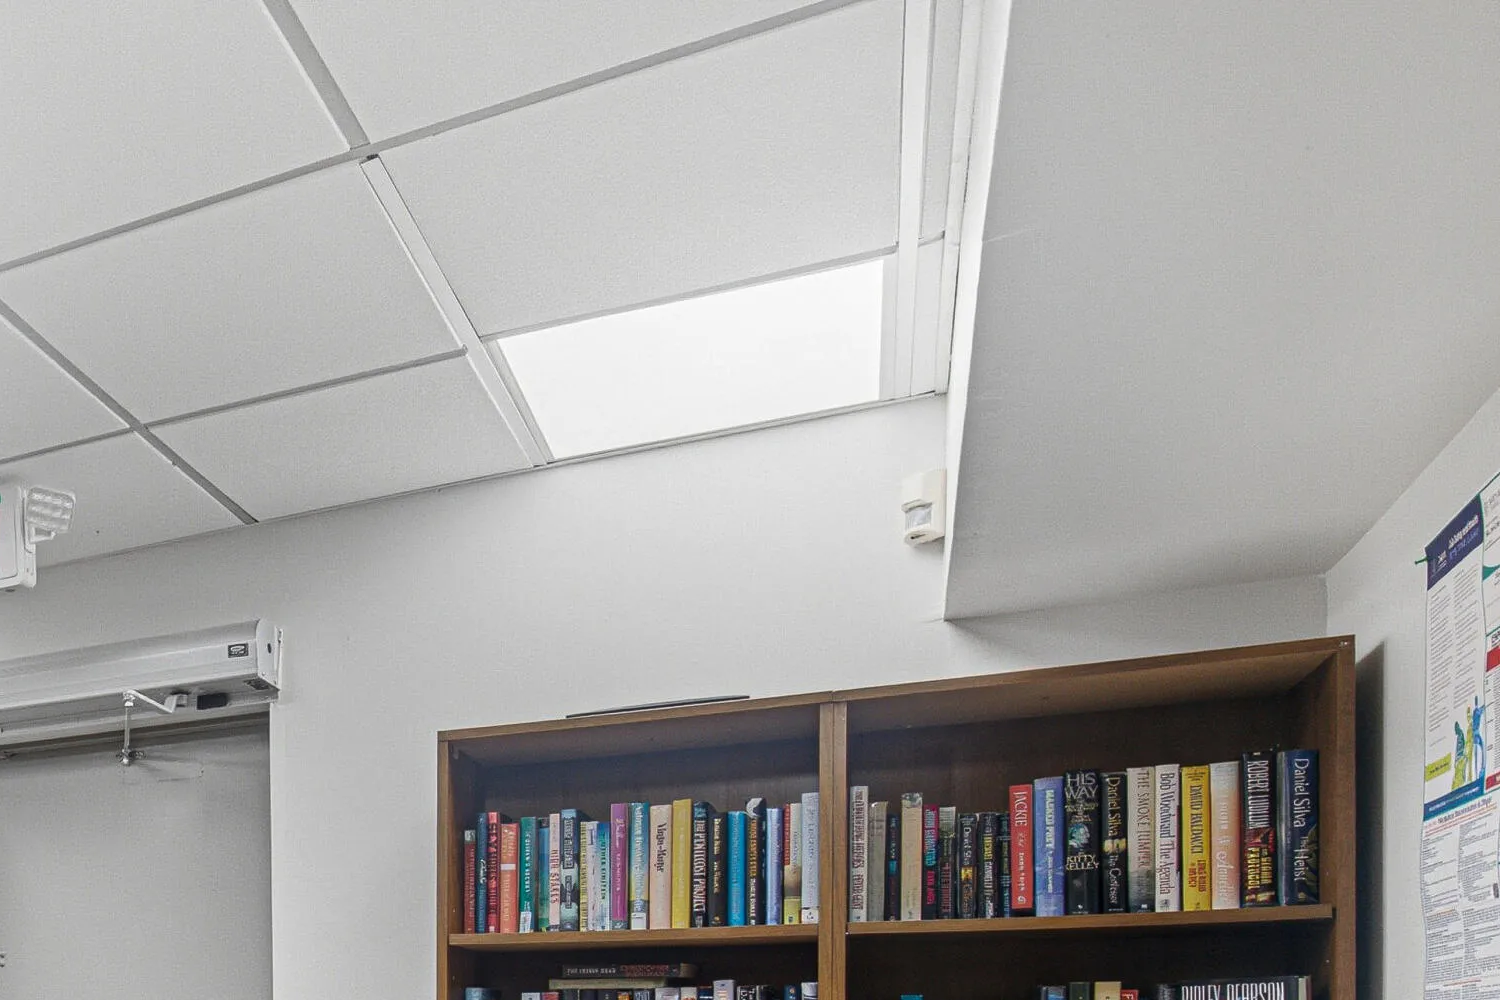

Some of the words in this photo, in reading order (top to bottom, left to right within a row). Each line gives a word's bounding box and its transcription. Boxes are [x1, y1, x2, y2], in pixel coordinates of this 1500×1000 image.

[1067, 772, 1095, 785] HIS
[1137, 771, 1150, 789] THE
[1160, 773, 1176, 790] Bob
[1247, 760, 1269, 792] ROBERT
[1294, 759, 1309, 795] Daniel
[1065, 785, 1098, 799] WAY
[1107, 778, 1120, 810] Daniel
[1190, 785, 1206, 810] DAVID
[1013, 791, 1028, 826] JACKIE
[1137, 793, 1150, 826] SMOKE
[1159, 791, 1175, 839] Woodward
[1247, 795, 1270, 829] LUDLUM
[1293, 799, 1310, 828] Silva
[1107, 813, 1121, 837] Silva
[1190, 813, 1206, 854] BALDACCI
[693, 833, 706, 876] PENTECOST
[1137, 830, 1151, 868] JUMPER
[1159, 841, 1175, 858] The
[1300, 836, 1308, 848] The
[551, 850, 559, 868] HIGH
[1065, 861, 1098, 871] KELLEY
[1067, 854, 1095, 863] KITTY
[1293, 849, 1308, 881] Heist
[550, 873, 560, 904] STAKES
[1157, 861, 1174, 895] Agenda
[693, 878, 706, 912] PROJECT
